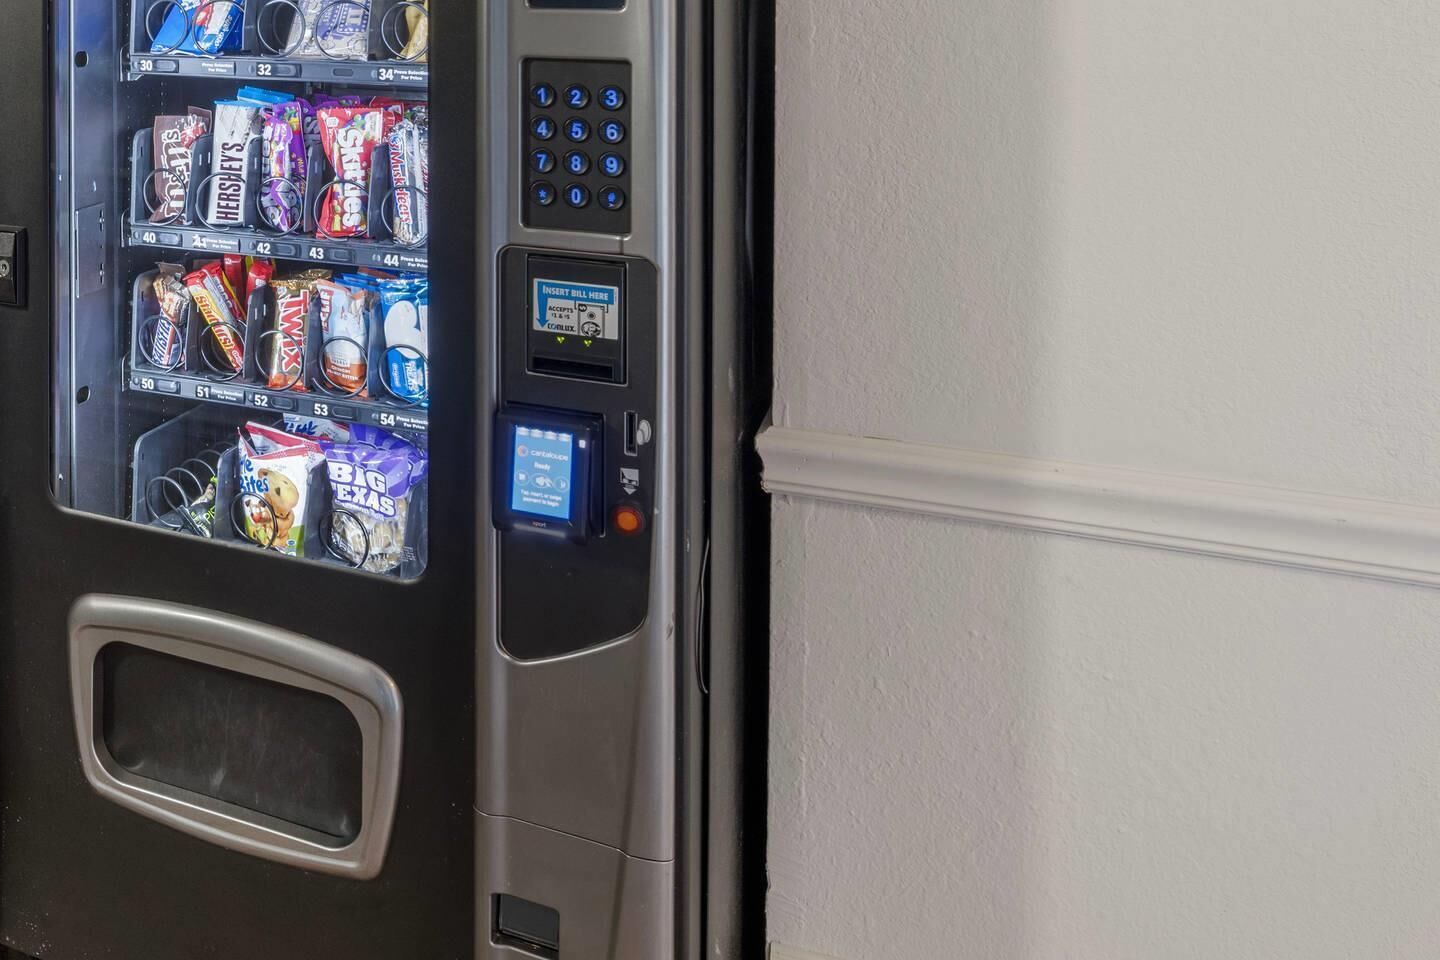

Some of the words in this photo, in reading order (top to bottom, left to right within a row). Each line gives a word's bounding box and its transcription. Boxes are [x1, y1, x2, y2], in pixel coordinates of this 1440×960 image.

[140, 59, 153, 71] 30
[258, 64, 272, 76] 32
[379, 68, 394, 81] 34
[538, 88, 545, 103] 1
[571, 90, 580, 104] 2
[605, 90, 617, 106] 3
[537, 121, 547, 136] 4
[571, 123, 580, 138] 5
[606, 124, 618, 140] 6
[537, 154, 546, 169] 7
[571, 156, 580, 171] 8
[606, 157, 618, 173] 9
[215, 142, 245, 221] HERSHEY'S
[337, 128, 365, 227] Skittles
[571, 189, 580, 204] 0
[143, 232, 156, 244] 40
[257, 243, 271, 254] 42
[310, 247, 324, 259] 43
[384, 254, 400, 267] 44
[543, 285, 569, 296] INSERT
[571, 289, 587, 298] BILL
[589, 291, 609, 301] HERE
[548, 305, 573, 313] ACCEPTS
[280, 289, 309, 371] TWIX
[141, 379, 154, 390] 50
[197, 386, 209, 398] 51
[254, 394, 268, 407] 52
[314, 403, 328, 416] 53
[380, 413, 396, 426] 54
[530, 448, 569, 461] cantaloupe
[328, 460, 386, 493] BIG
[332, 483, 395, 517] EXAS
